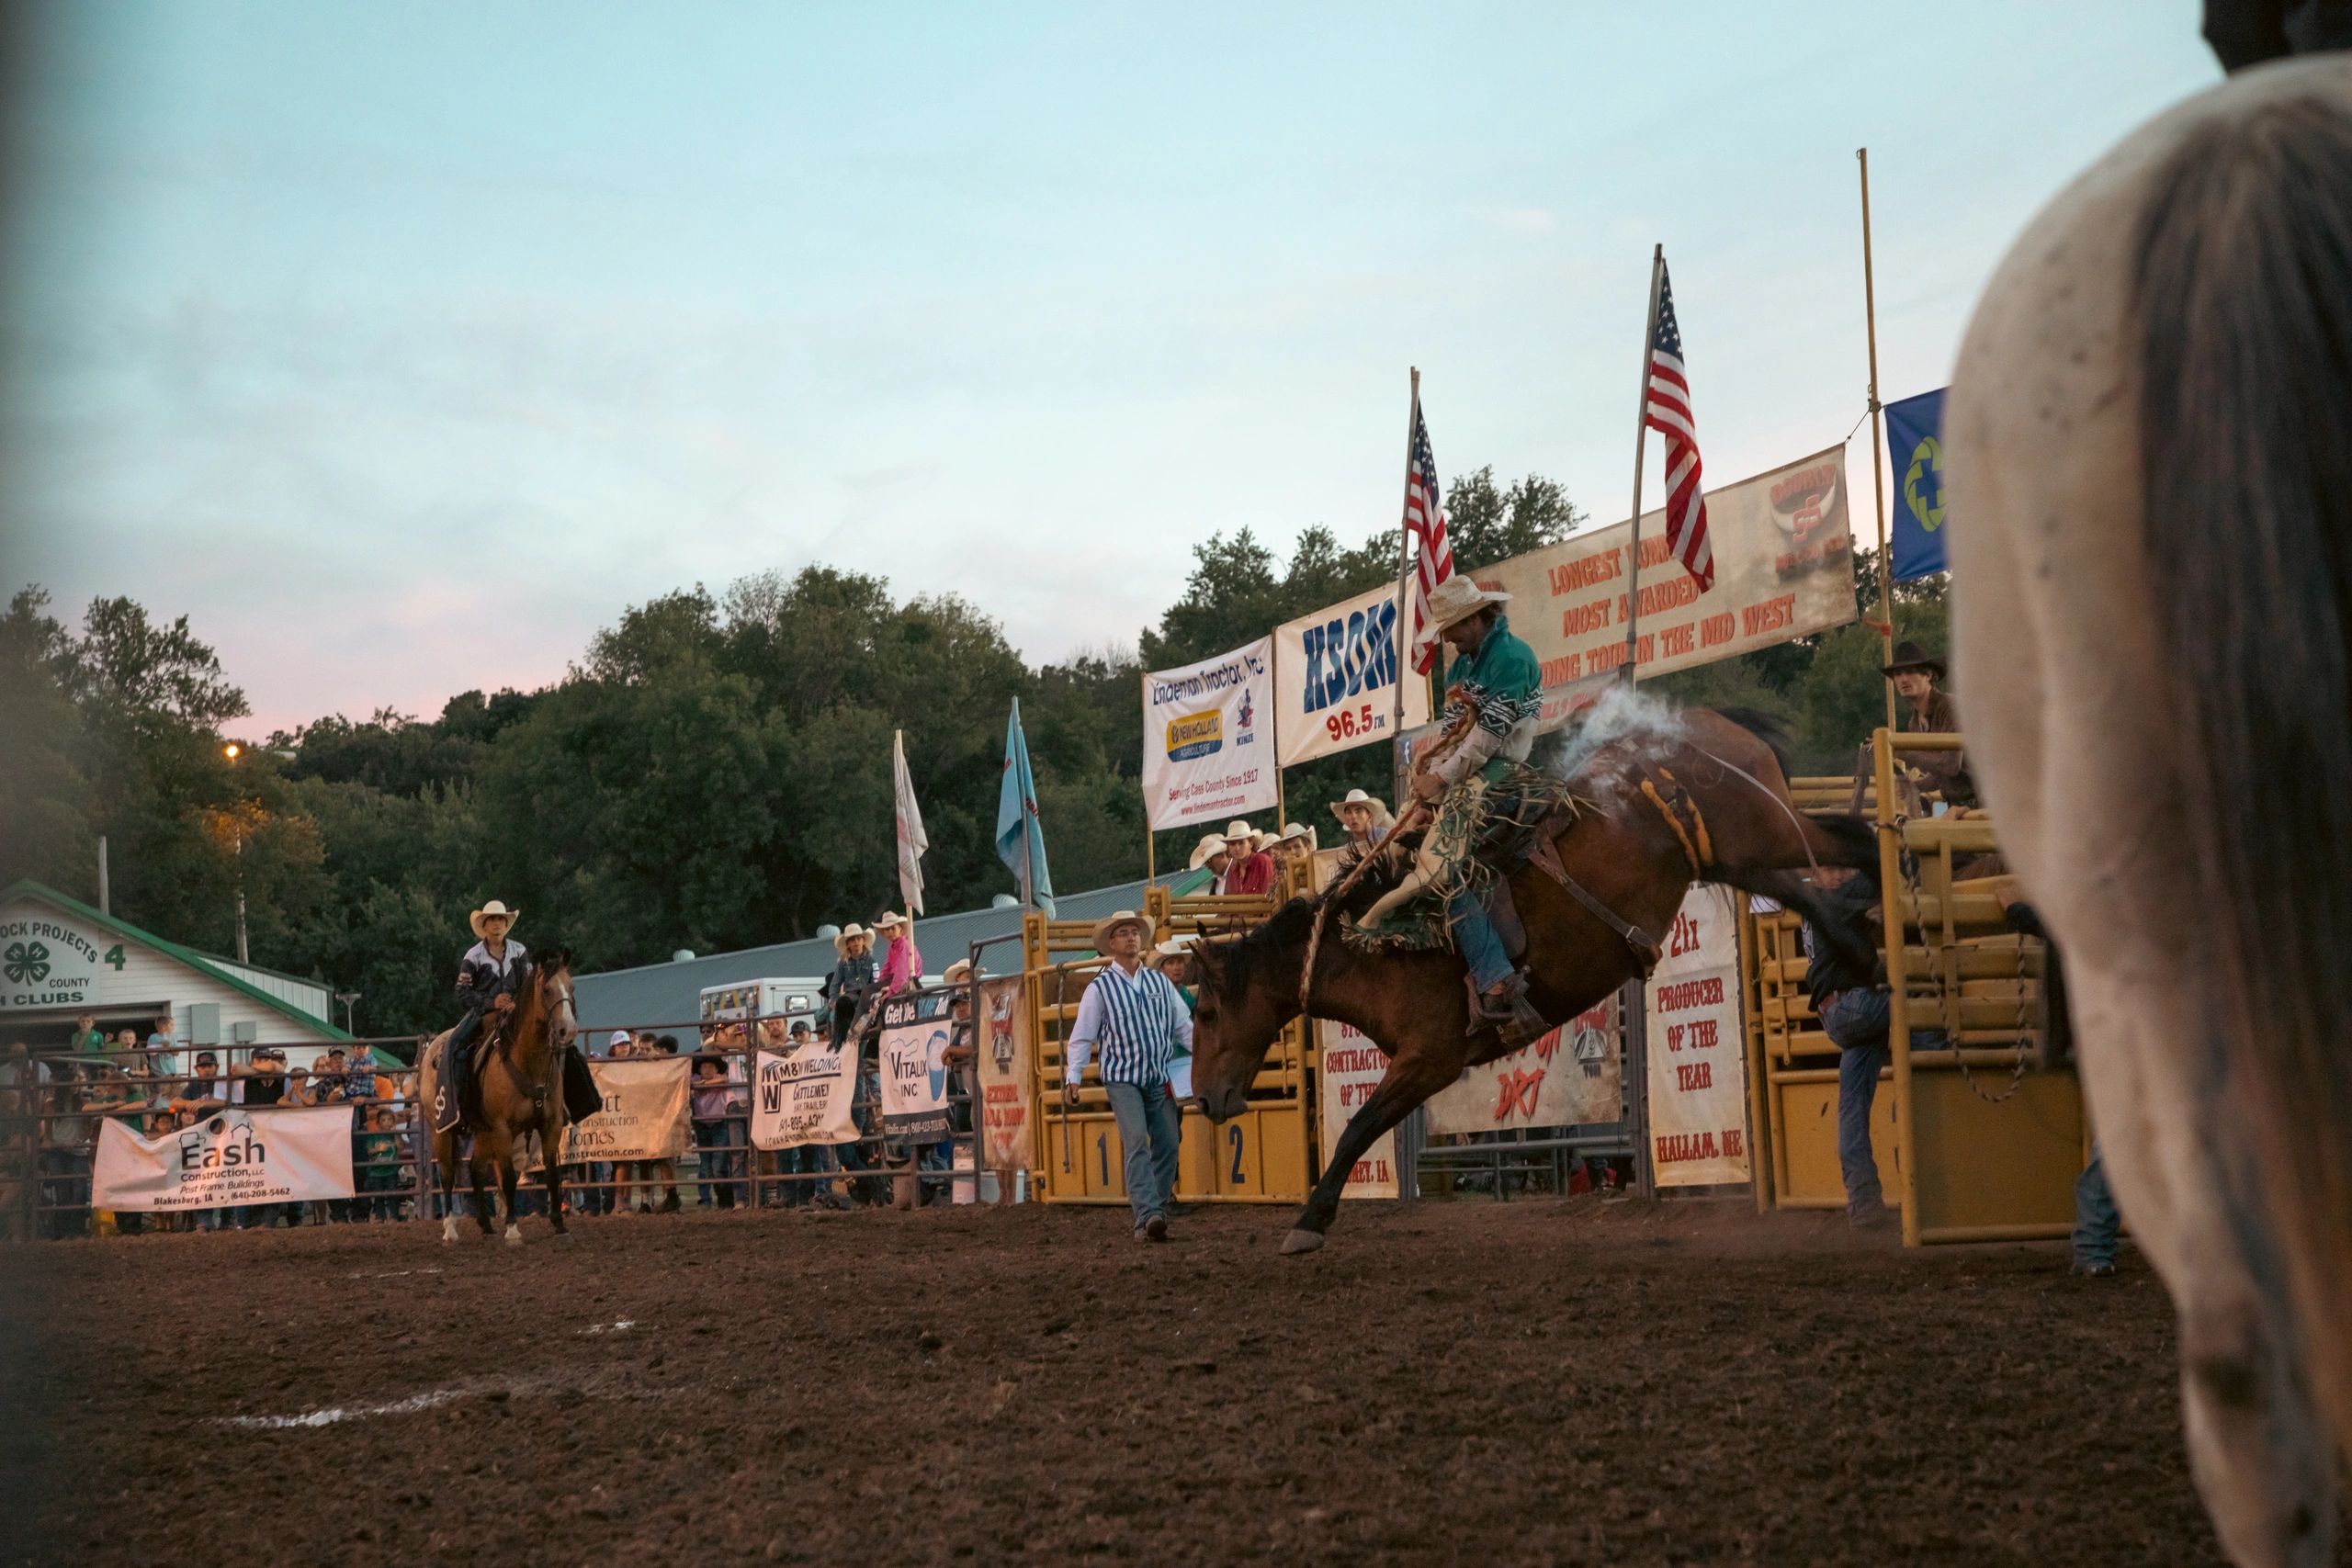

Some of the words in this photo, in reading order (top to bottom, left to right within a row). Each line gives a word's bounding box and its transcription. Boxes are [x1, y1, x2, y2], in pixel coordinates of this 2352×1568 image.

[1548, 548, 1623, 596] LONGEST
[1564, 599, 1611, 638] MOST
[1303, 597, 1396, 714] KSOM
[1541, 653, 1581, 690] DING
[1586, 640, 1629, 676] TOUR
[1636, 633, 1655, 666] IN
[1660, 623, 1695, 659] THE
[1700, 612, 1736, 648] MID
[1742, 593, 1795, 637] WEST
[1180, 724, 1193, 741] NEW
[1326, 705, 1374, 741] 96.5
[1374, 714, 1385, 729] FM
[1237, 733, 1254, 747] KINZE
[1169, 785, 1191, 801] Serving
[1191, 783, 1204, 796] Cass
[1204, 778, 1225, 794] County
[1226, 774, 1242, 789] Since
[1243, 768, 1259, 785] 1917
[0, 922, 28, 939] OCK
[32, 922, 98, 964] PROJECTS
[104, 943, 127, 972] 4
[49, 977, 90, 988] COUNTY
[1657, 977, 1724, 1014] PRODUCER
[13, 991, 85, 1006] CLUBS
[885, 1003, 903, 1025] Get
[1668, 1025, 1685, 1053] OF
[1687, 1020, 1719, 1049] THE
[1677, 1061, 1713, 1093] YEAR
[762, 1085, 778, 1111] W
[1340, 1084, 1354, 1107] OF
[580, 1114, 639, 1128] onstruction
[181, 1137, 266, 1171] Eash
[1228, 1123, 1246, 1184] 2
[1722, 1129, 1743, 1157] NE
[1097, 1131, 1109, 1187] 1
[1375, 1159, 1390, 1183] IA
[180, 1167, 251, 1183] Construction,
[252, 1168, 265, 1177] LLC
[180, 1184, 198, 1195] Post
[199, 1182, 225, 1192] Frame
[227, 1177, 266, 1190] Buildings
[153, 1196, 202, 1206] Blakesburg,
[204, 1193, 214, 1203] IA
